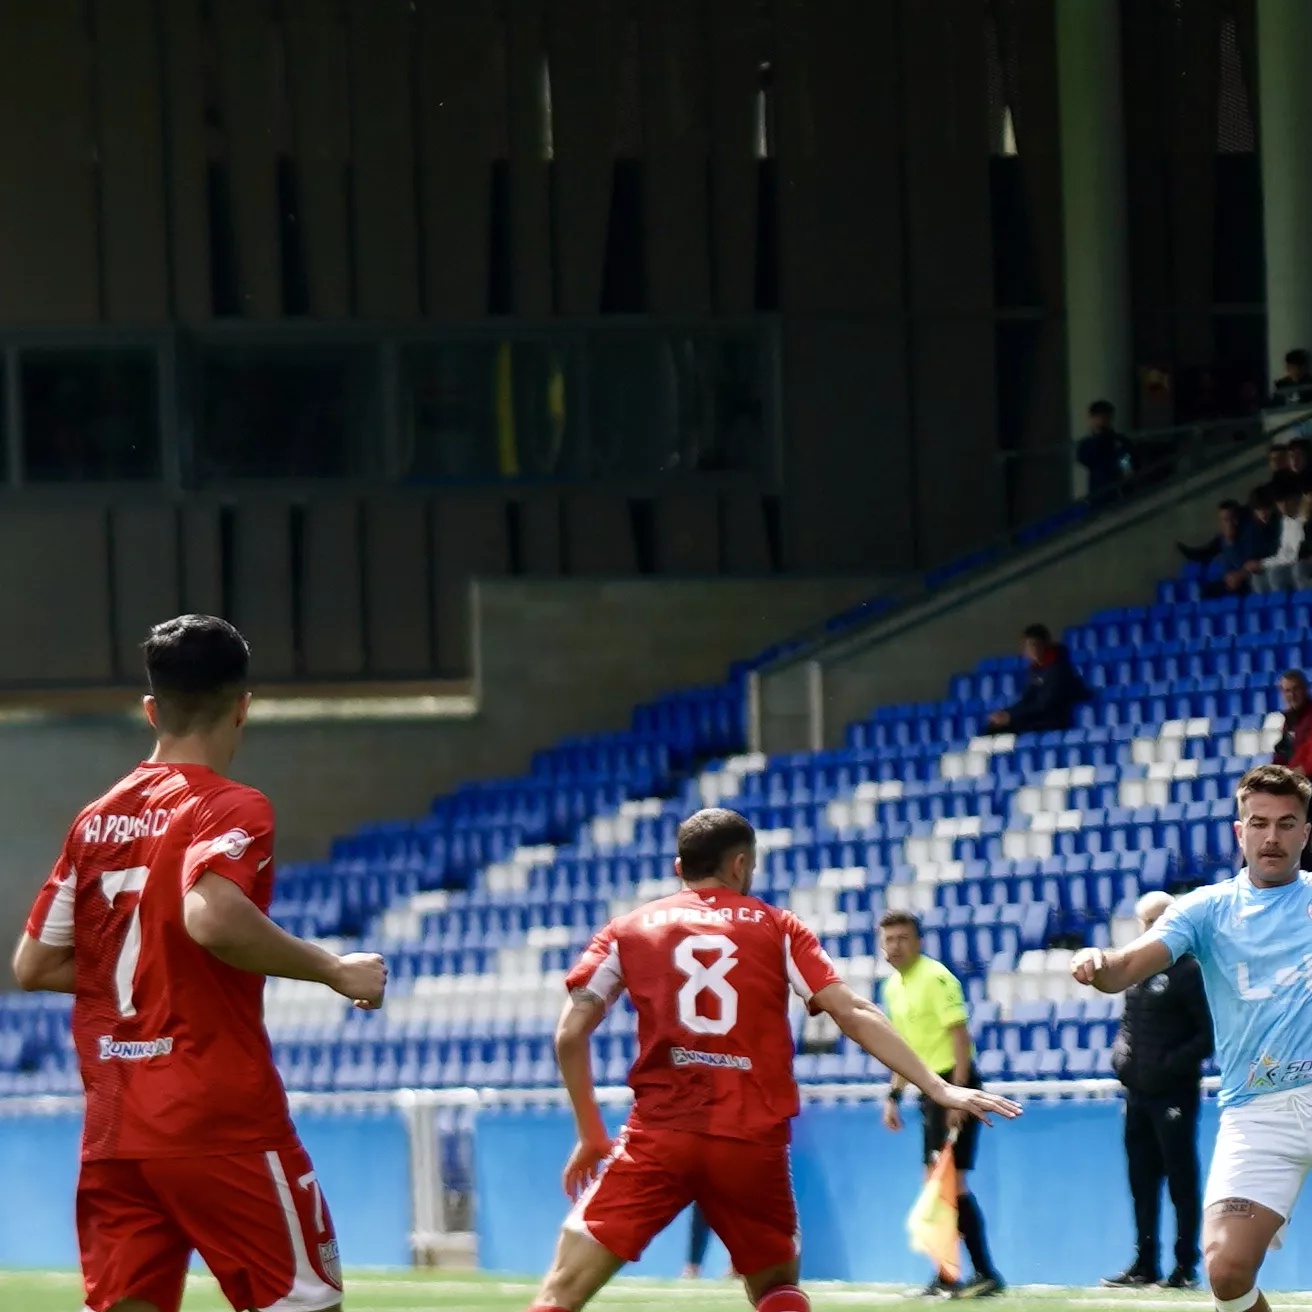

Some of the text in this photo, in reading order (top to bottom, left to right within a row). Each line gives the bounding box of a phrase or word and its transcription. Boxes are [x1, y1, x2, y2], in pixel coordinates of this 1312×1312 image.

[101, 865, 150, 1017] 7
[673, 934, 739, 1036] 8
[298, 1170, 326, 1234] 7
